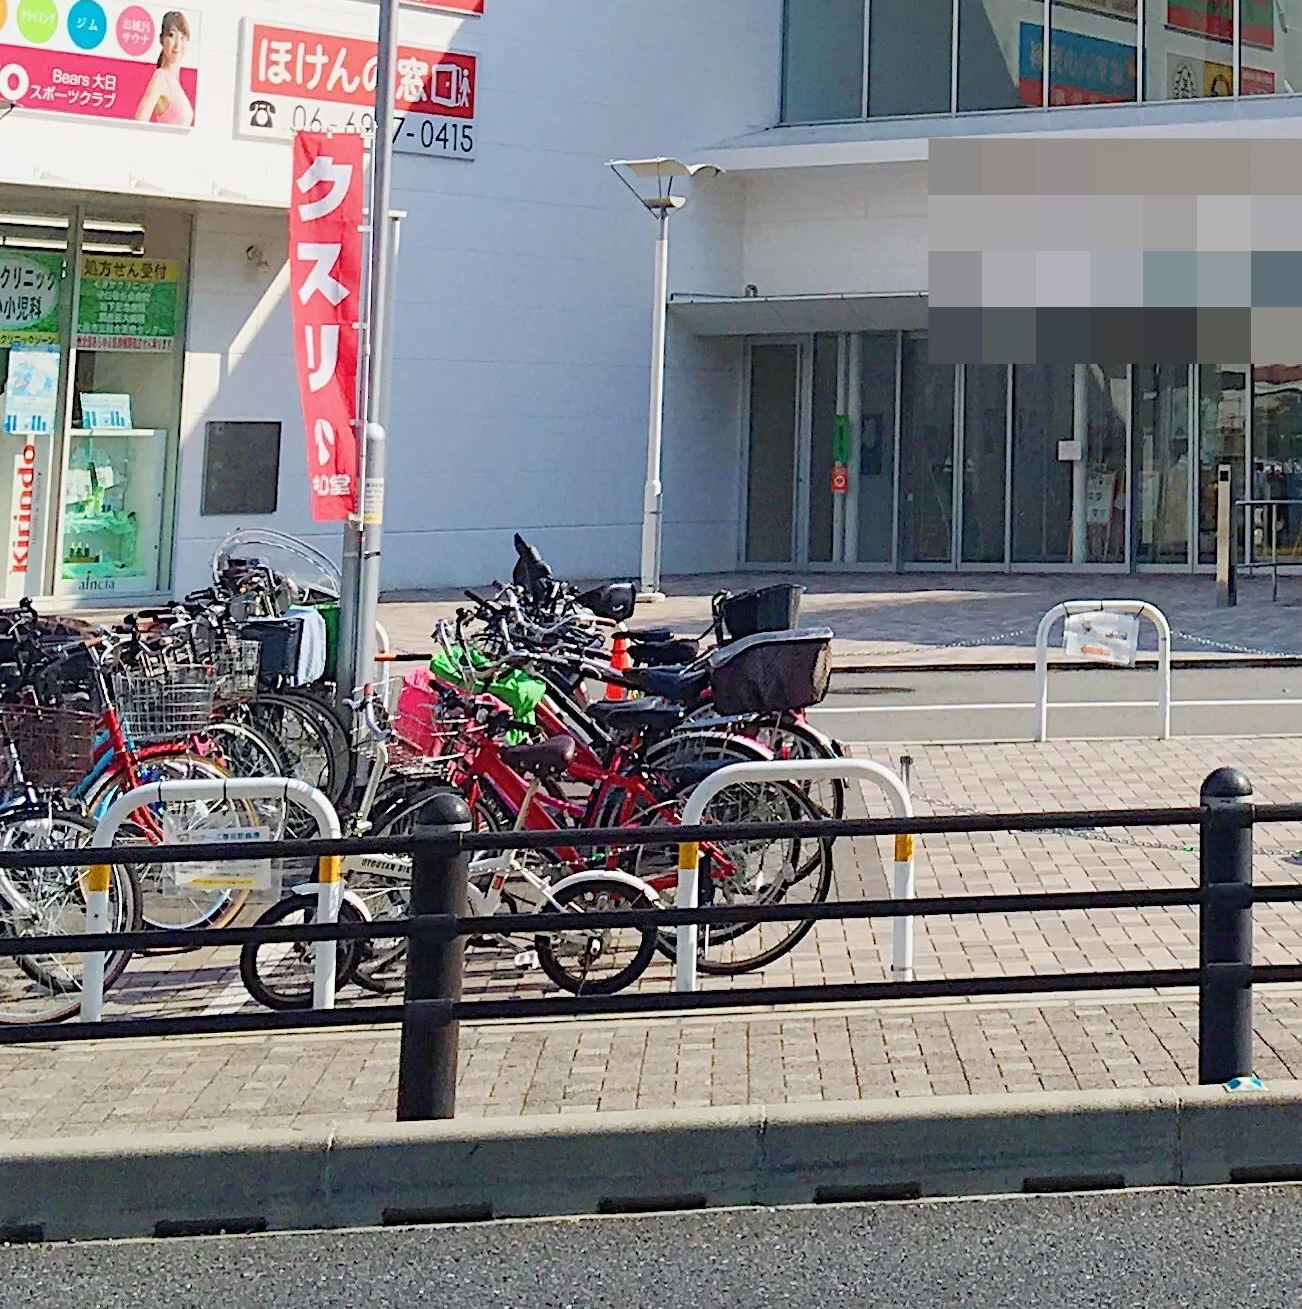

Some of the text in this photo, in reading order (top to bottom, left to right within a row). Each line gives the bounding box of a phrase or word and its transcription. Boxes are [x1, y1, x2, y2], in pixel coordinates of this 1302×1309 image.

[52, 67, 117, 92] Bears 大日
[30, 83, 117, 109] スポーツクラブ
[84, 258, 167, 280] 処方せん受付
